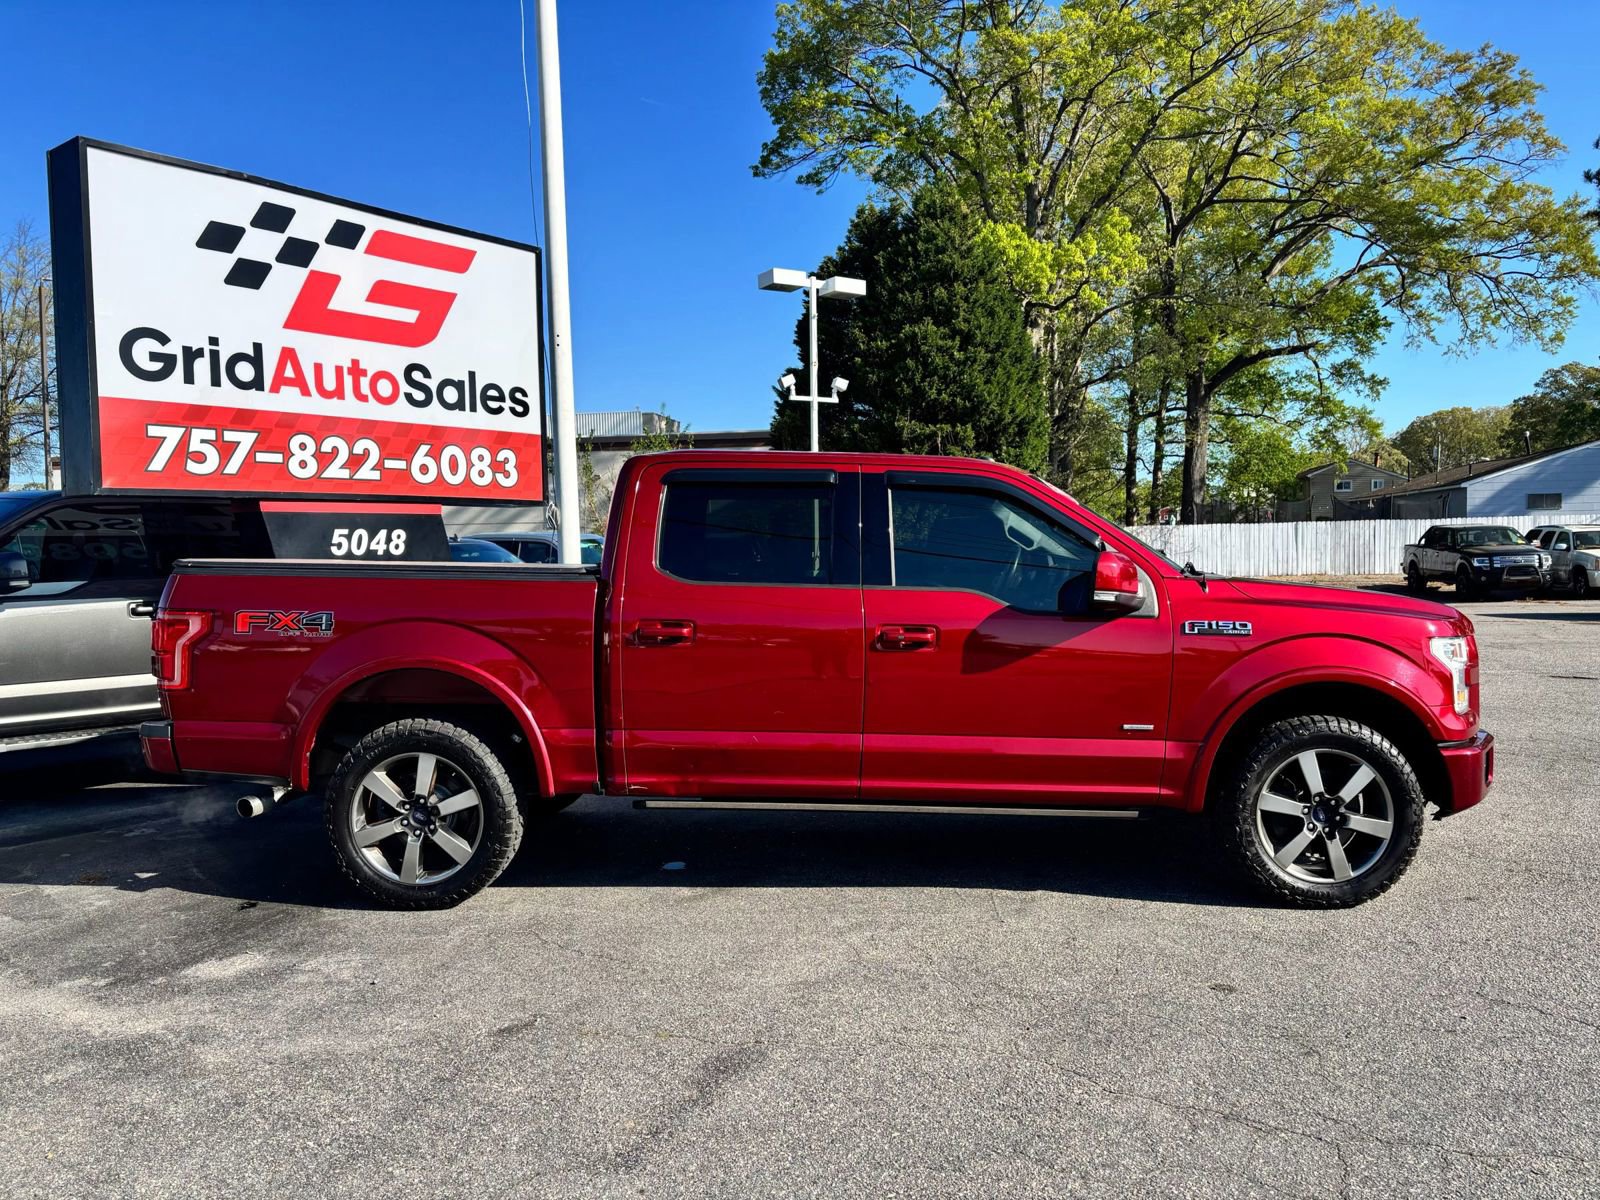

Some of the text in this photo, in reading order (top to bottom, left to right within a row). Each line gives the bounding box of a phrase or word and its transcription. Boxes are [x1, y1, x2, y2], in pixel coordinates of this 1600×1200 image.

[118, 326, 530, 418] GridAutoSales
[144, 423, 519, 488] 757-822-6083
[330, 528, 407, 556] 5048
[234, 609, 335, 634] FX4
